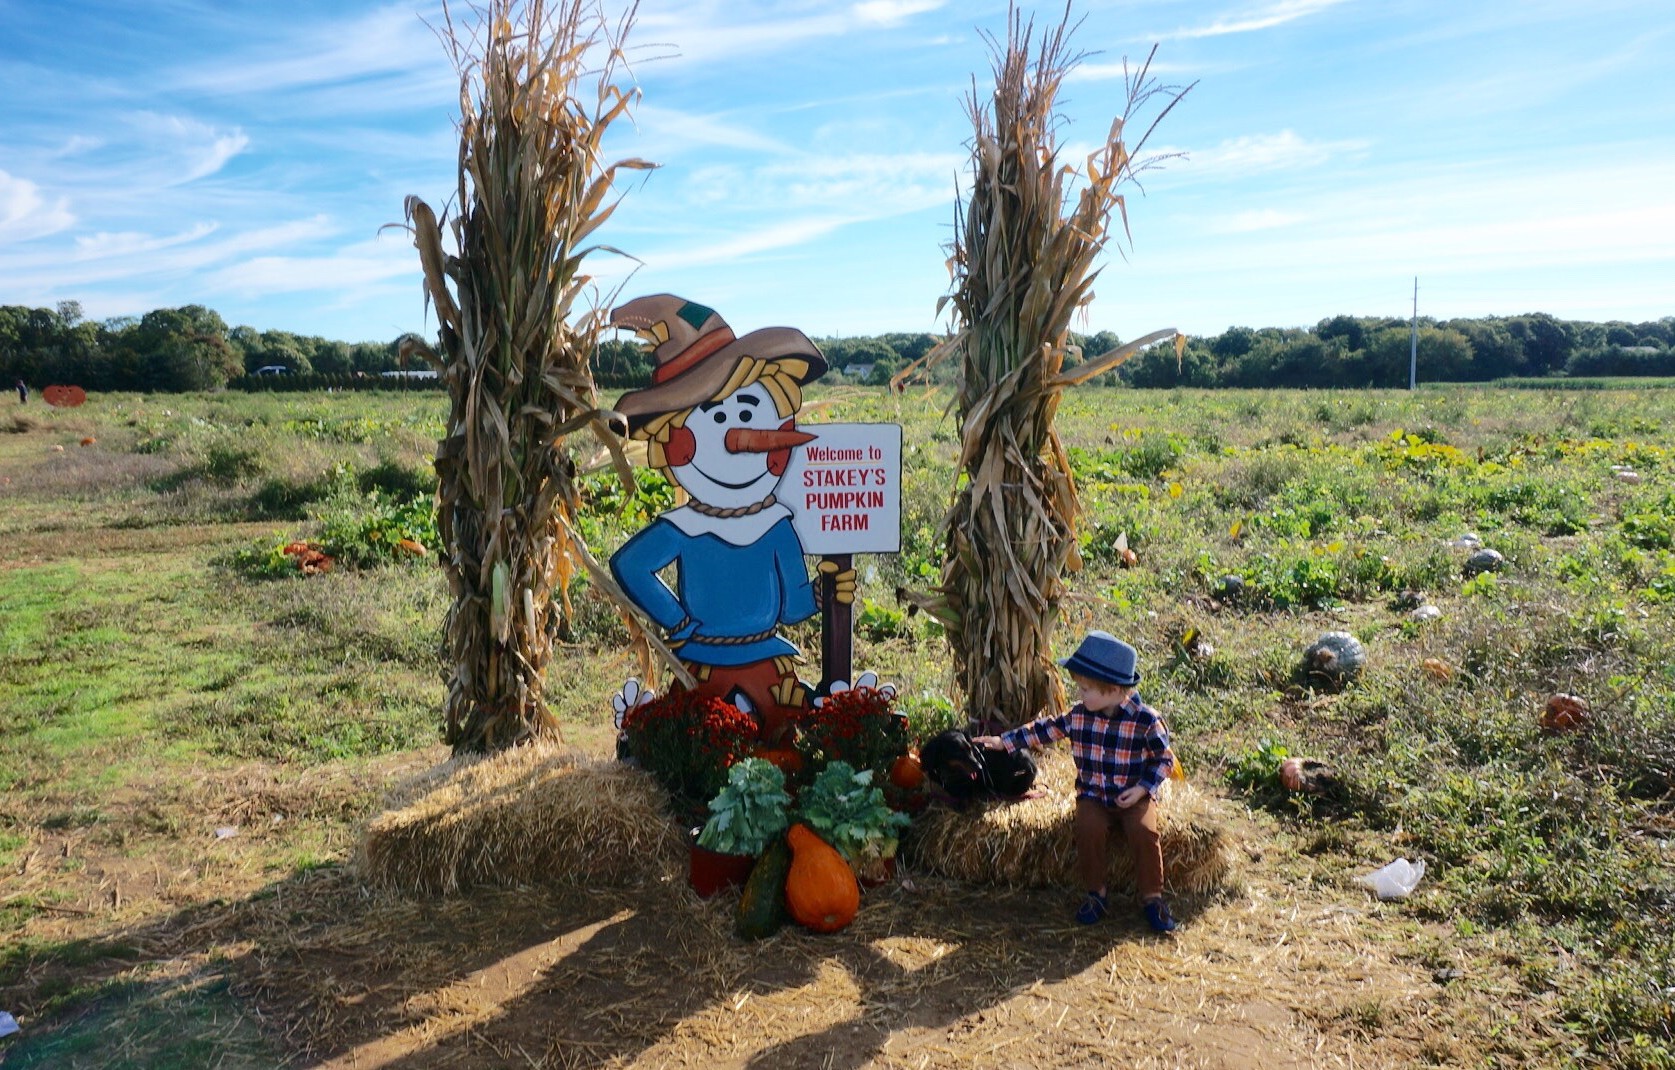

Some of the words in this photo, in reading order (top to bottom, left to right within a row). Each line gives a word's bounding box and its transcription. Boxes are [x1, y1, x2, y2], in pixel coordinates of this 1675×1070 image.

[806, 446, 863, 461] Welcome
[869, 445, 881, 460] to
[803, 468, 886, 487] STAKEY'S
[806, 491, 884, 510] PUMPKIN
[821, 514, 869, 531] FARM
